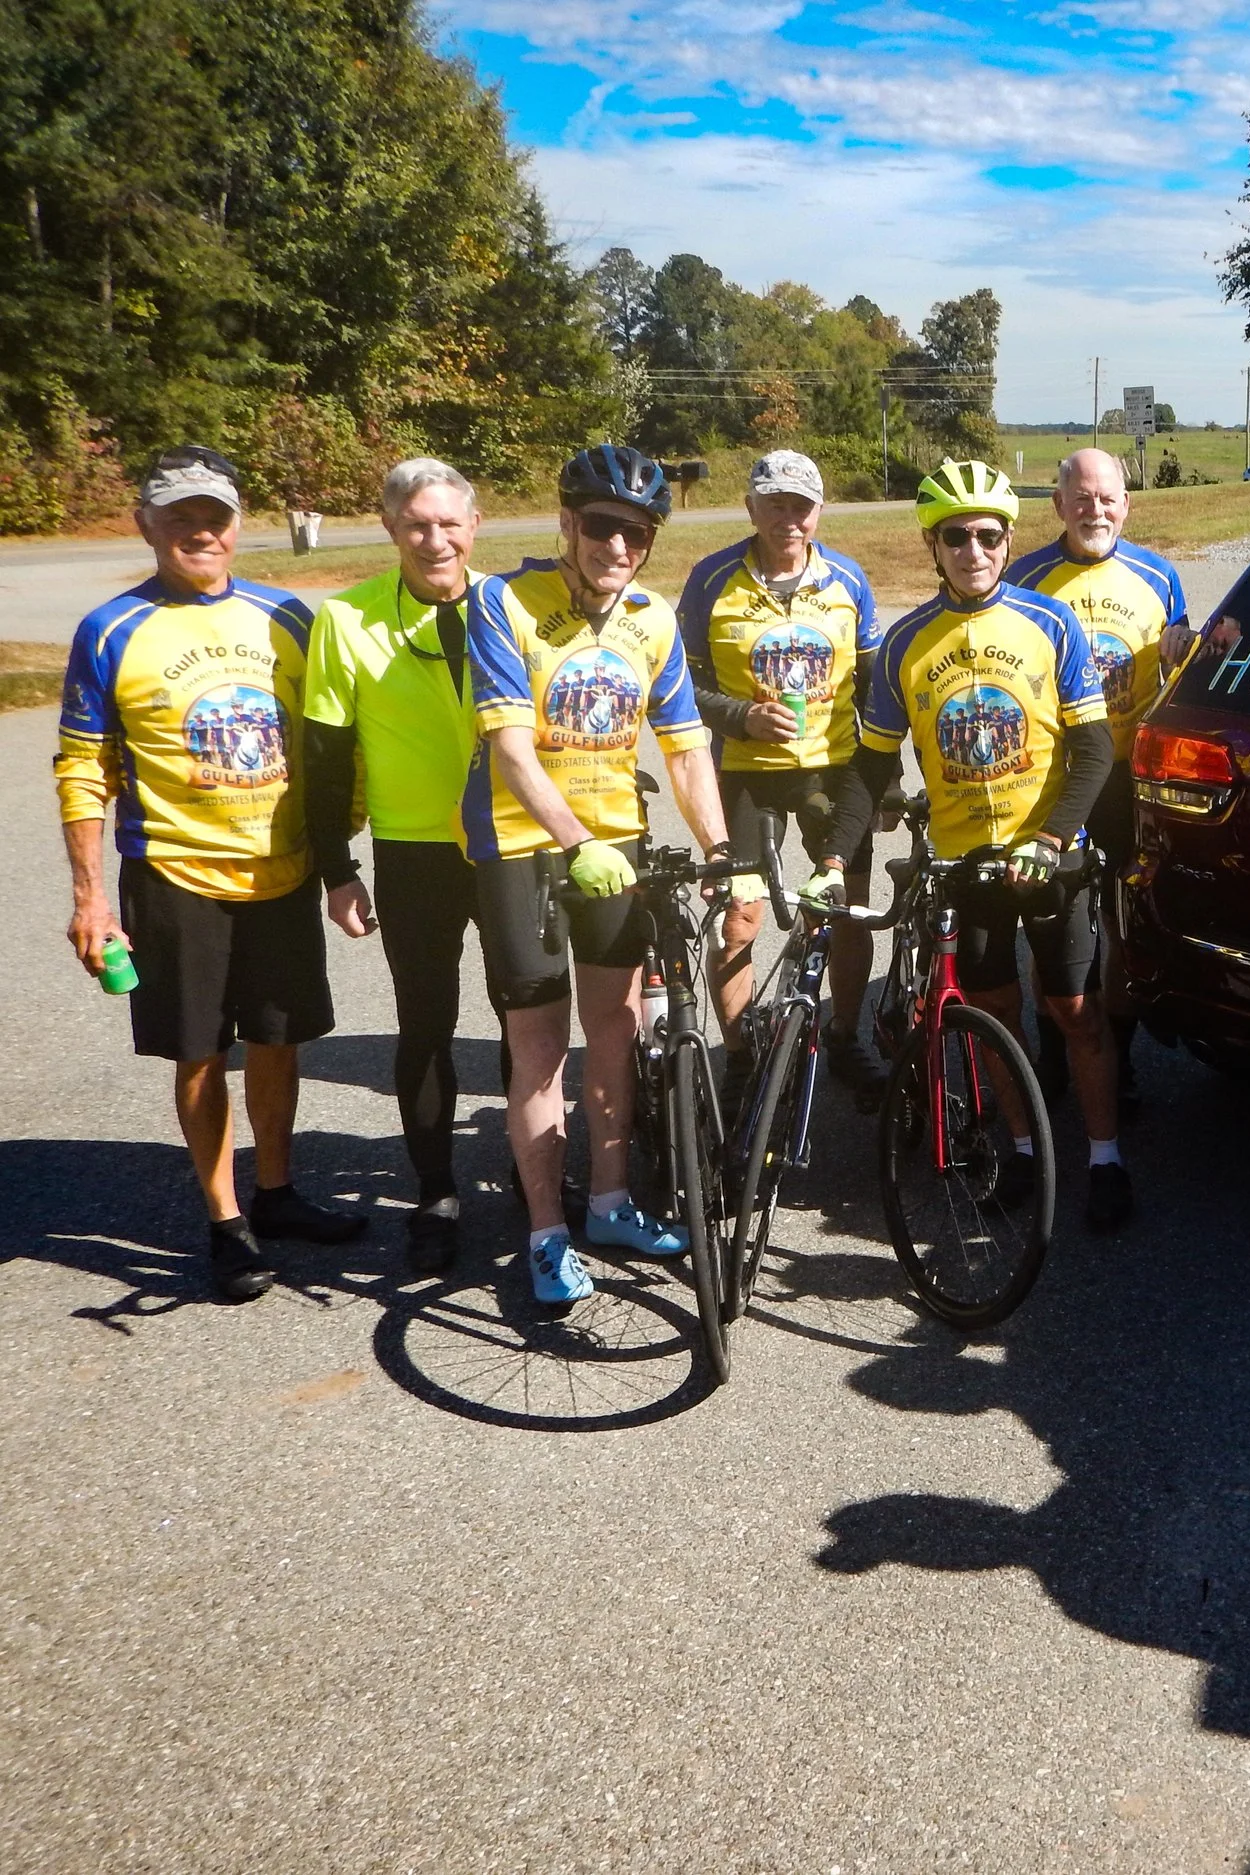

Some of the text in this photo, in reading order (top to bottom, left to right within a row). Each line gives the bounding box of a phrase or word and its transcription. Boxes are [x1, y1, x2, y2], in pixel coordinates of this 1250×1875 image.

[798, 593, 832, 615] Goat
[1080, 597, 1096, 609] to
[1101, 597, 1135, 620] Goat
[535, 610, 567, 641] Gulf
[617, 616, 650, 645] Goat
[550, 629, 588, 654] CHARITY
[163, 643, 282, 680] Gulf to Goat
[927, 645, 1024, 683] Gulf to Goat
[936, 667, 1016, 694] CHARITY BIKE RIDE
[551, 731, 590, 747] GULF
[607, 731, 633, 746] GOAT
[541, 758, 562, 768] ITED
[563, 756, 592, 768] STATES
[948, 764, 978, 779] GULF
[993, 755, 1022, 775] GOAT
[202, 768, 244, 785] GULF
[568, 777, 590, 785] Class
[1007, 776, 1038, 791] ACADEMY
[220, 794, 250, 806] STATES
[568, 787, 587, 796] 50th
[993, 800, 1011, 809] 1975
